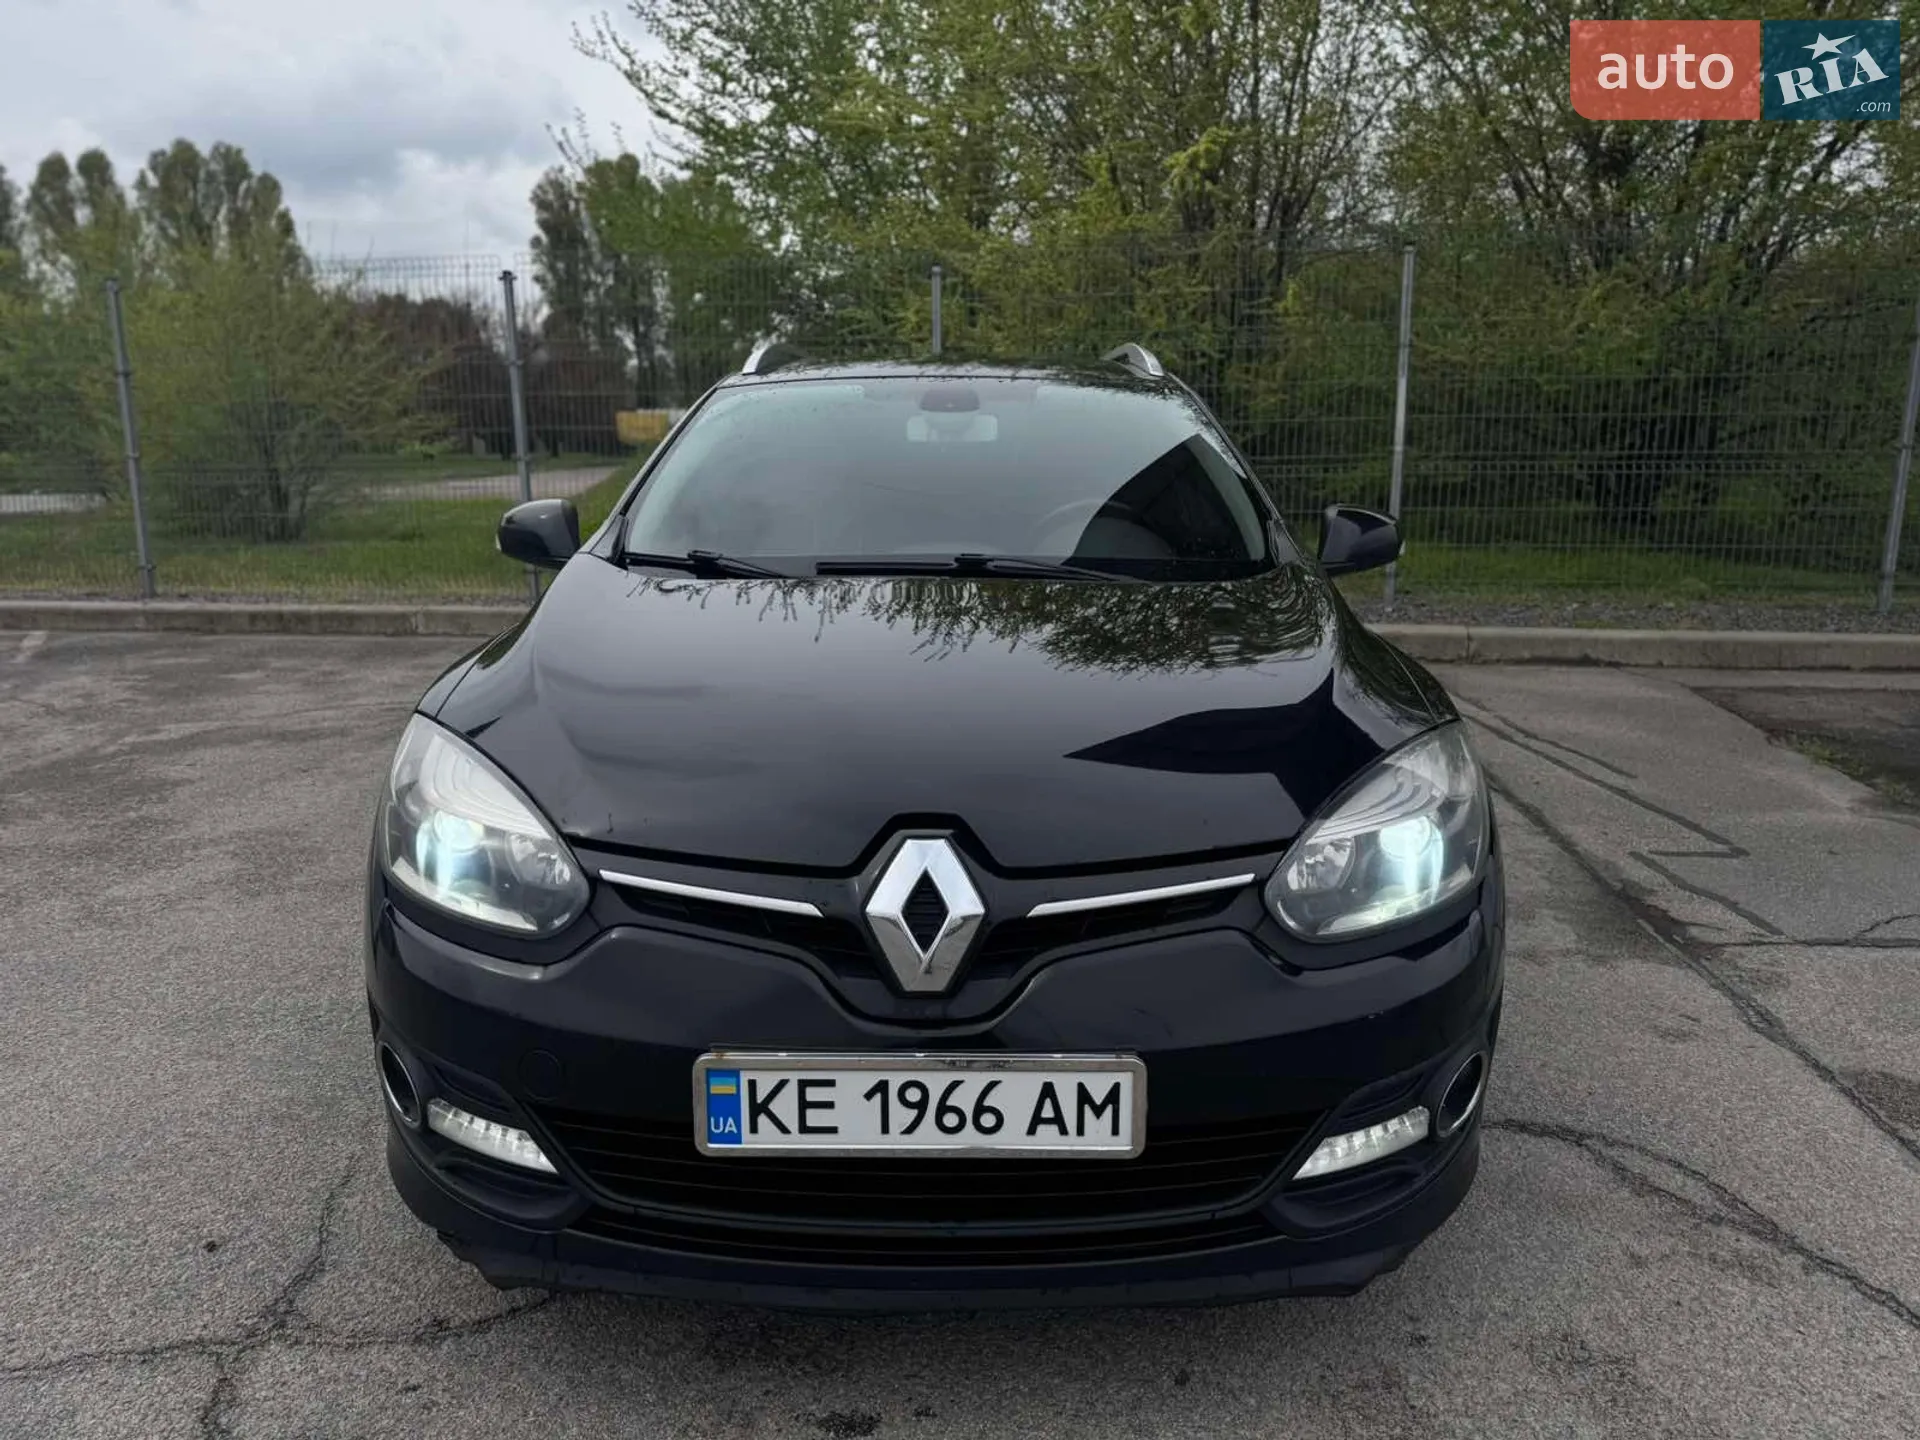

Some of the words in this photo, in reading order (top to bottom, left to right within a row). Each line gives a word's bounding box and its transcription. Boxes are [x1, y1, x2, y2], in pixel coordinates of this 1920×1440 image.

[710, 1116, 738, 1134] UA
[747, 1078, 839, 1135] KE
[863, 1079, 1004, 1135] 1966
[1025, 1081, 1121, 1137] AM
